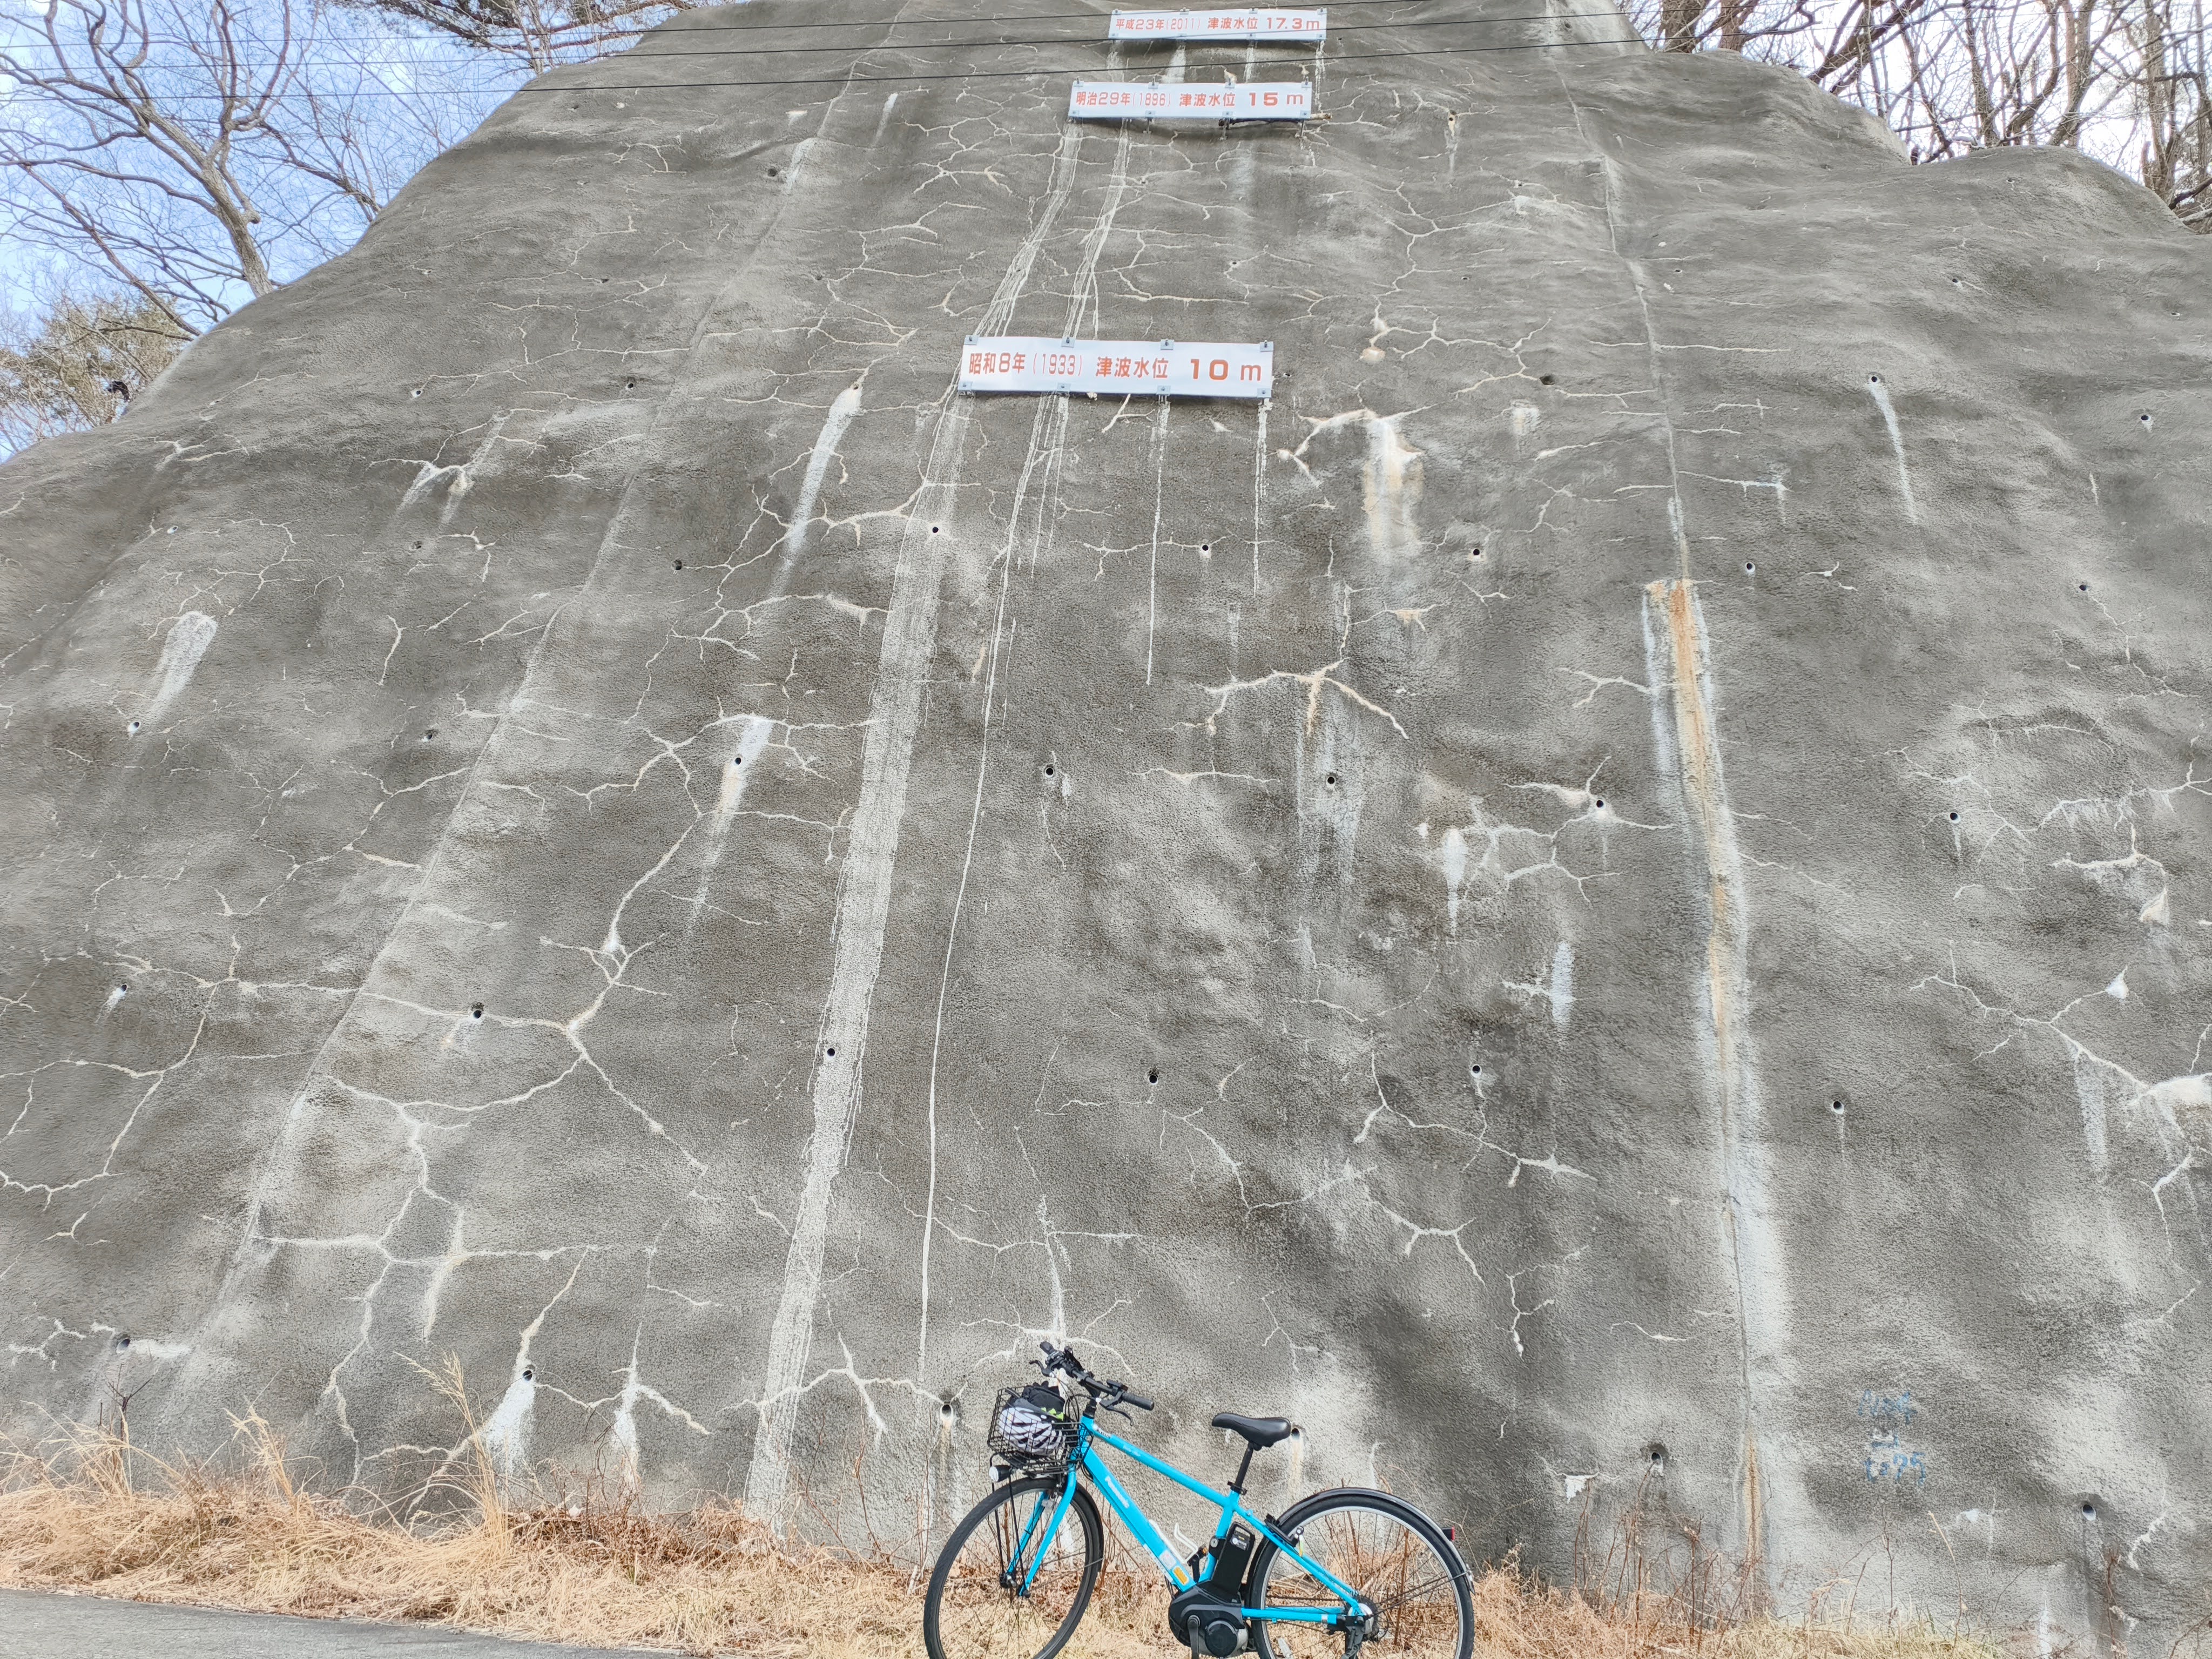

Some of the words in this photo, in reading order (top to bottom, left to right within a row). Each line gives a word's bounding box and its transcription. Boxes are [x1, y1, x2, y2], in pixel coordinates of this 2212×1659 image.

[1208, 17, 1258, 30] 津波水位
[1179, 92, 1236, 107] 津波水位
[1095, 356, 1169, 379] 津波水位
